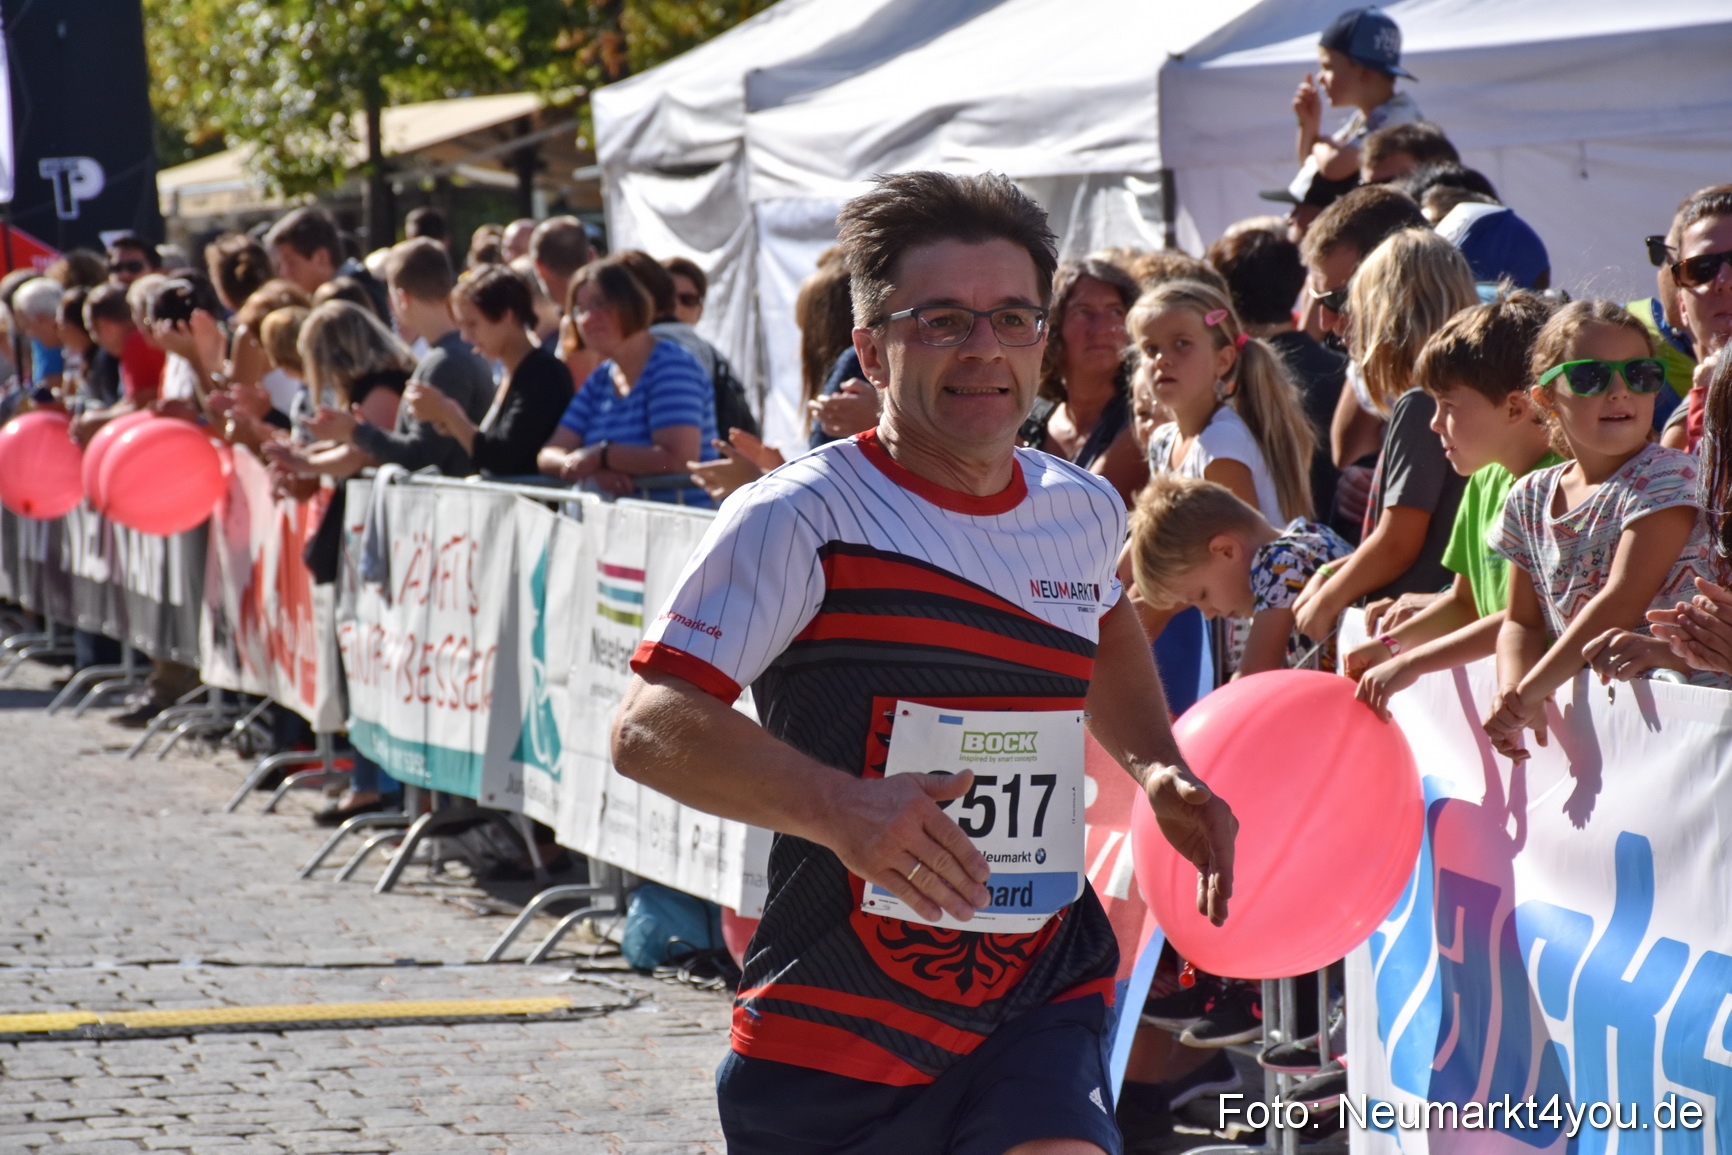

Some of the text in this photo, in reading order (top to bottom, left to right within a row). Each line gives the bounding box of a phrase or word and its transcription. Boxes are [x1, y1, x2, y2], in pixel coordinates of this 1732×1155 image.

[1030, 579, 1093, 601] NEUMARKT
[961, 731, 1038, 754] BOCK
[959, 754, 988, 763] inspired
[989, 755, 996, 764] by
[1014, 755, 1038, 763] concepts
